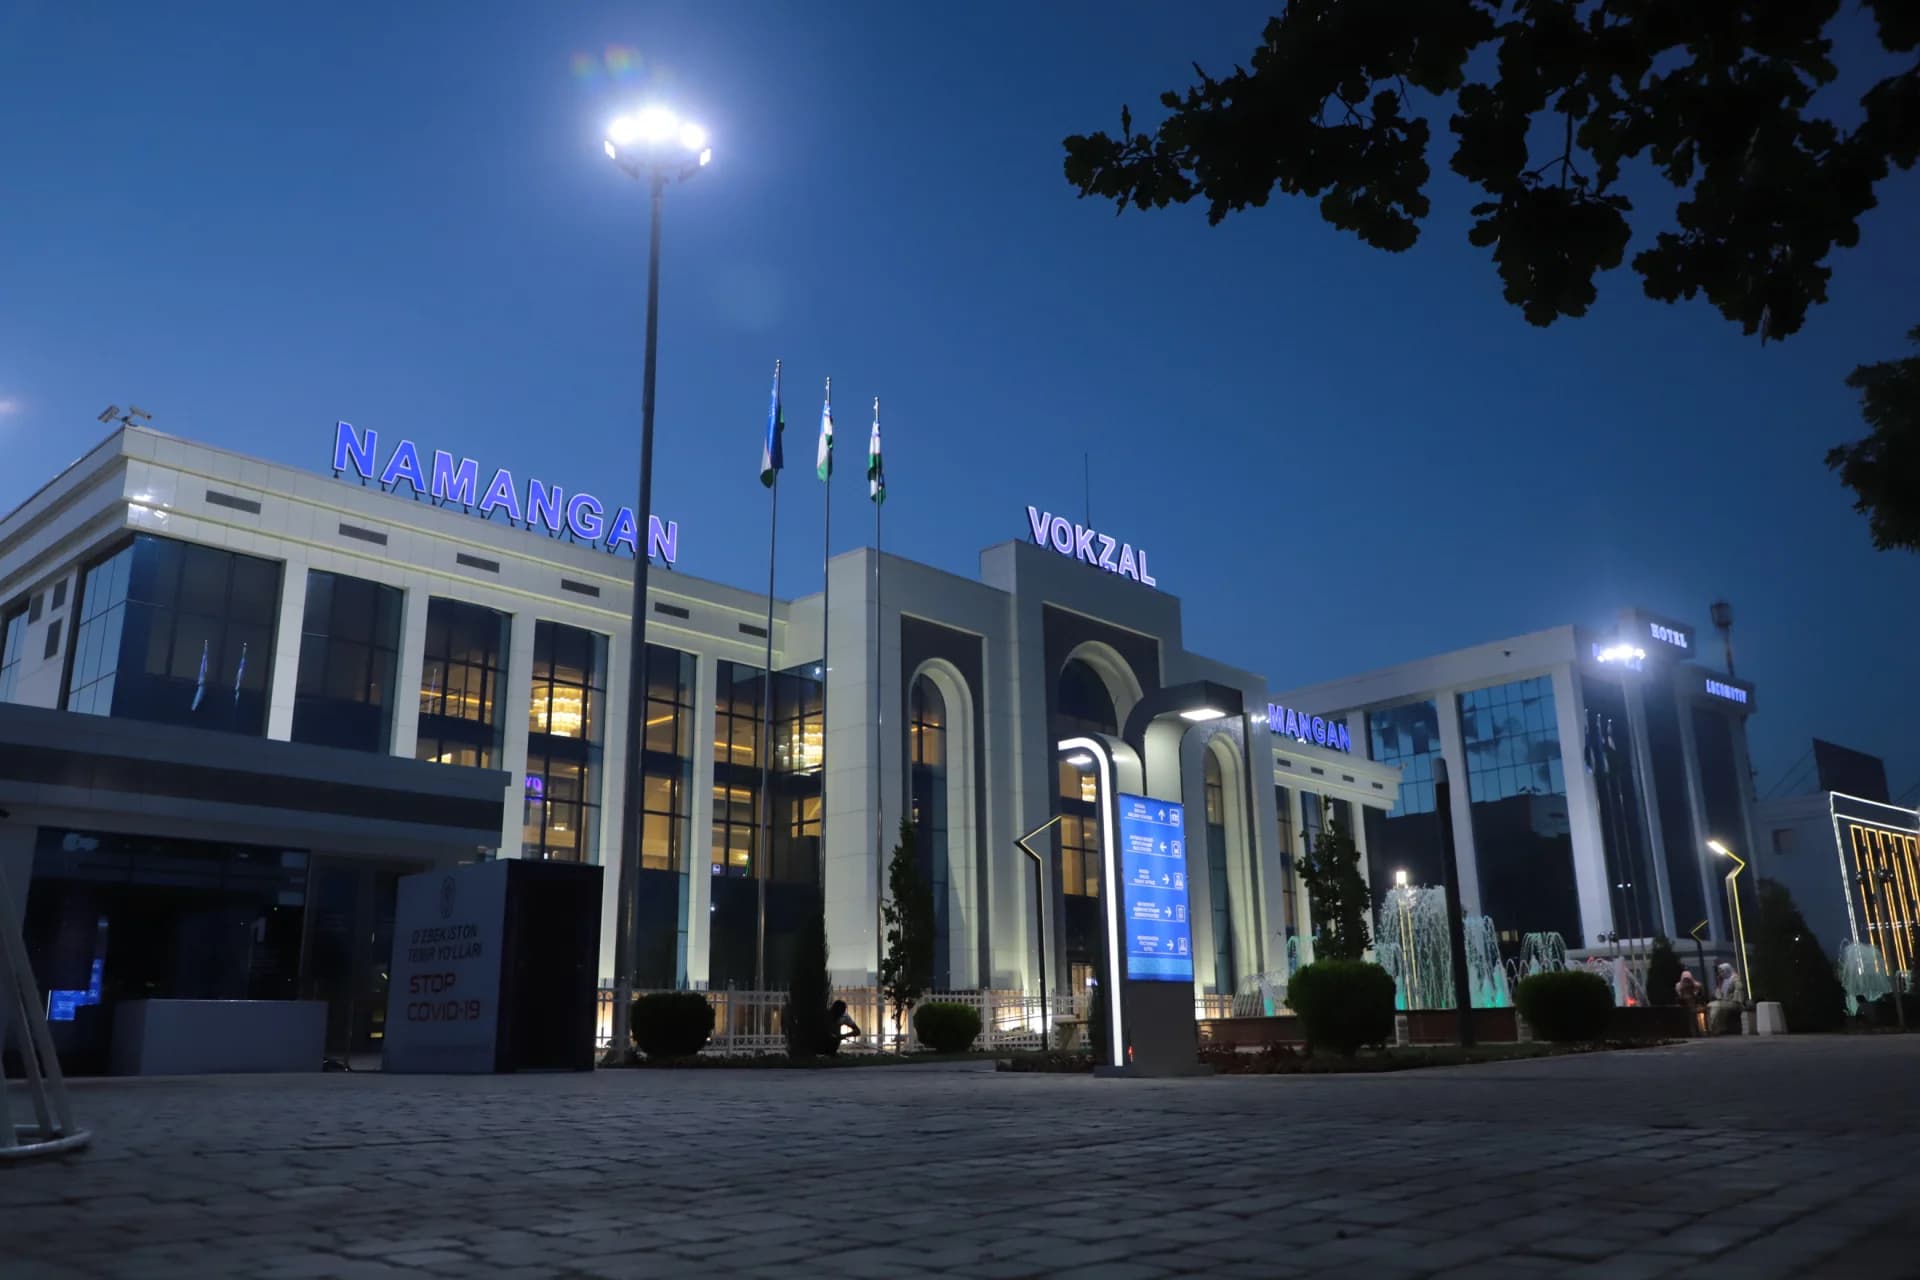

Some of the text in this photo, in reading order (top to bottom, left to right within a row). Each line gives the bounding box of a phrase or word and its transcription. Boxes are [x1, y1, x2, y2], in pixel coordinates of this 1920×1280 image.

[333, 420, 678, 563] NAMANGAN
[1027, 506, 1156, 587] VOKZAL
[1650, 623, 1687, 648] HOTEL
[1267, 703, 1352, 753] MANGAN
[410, 973, 456, 993] STOP
[407, 999, 481, 1022] COVID-19
